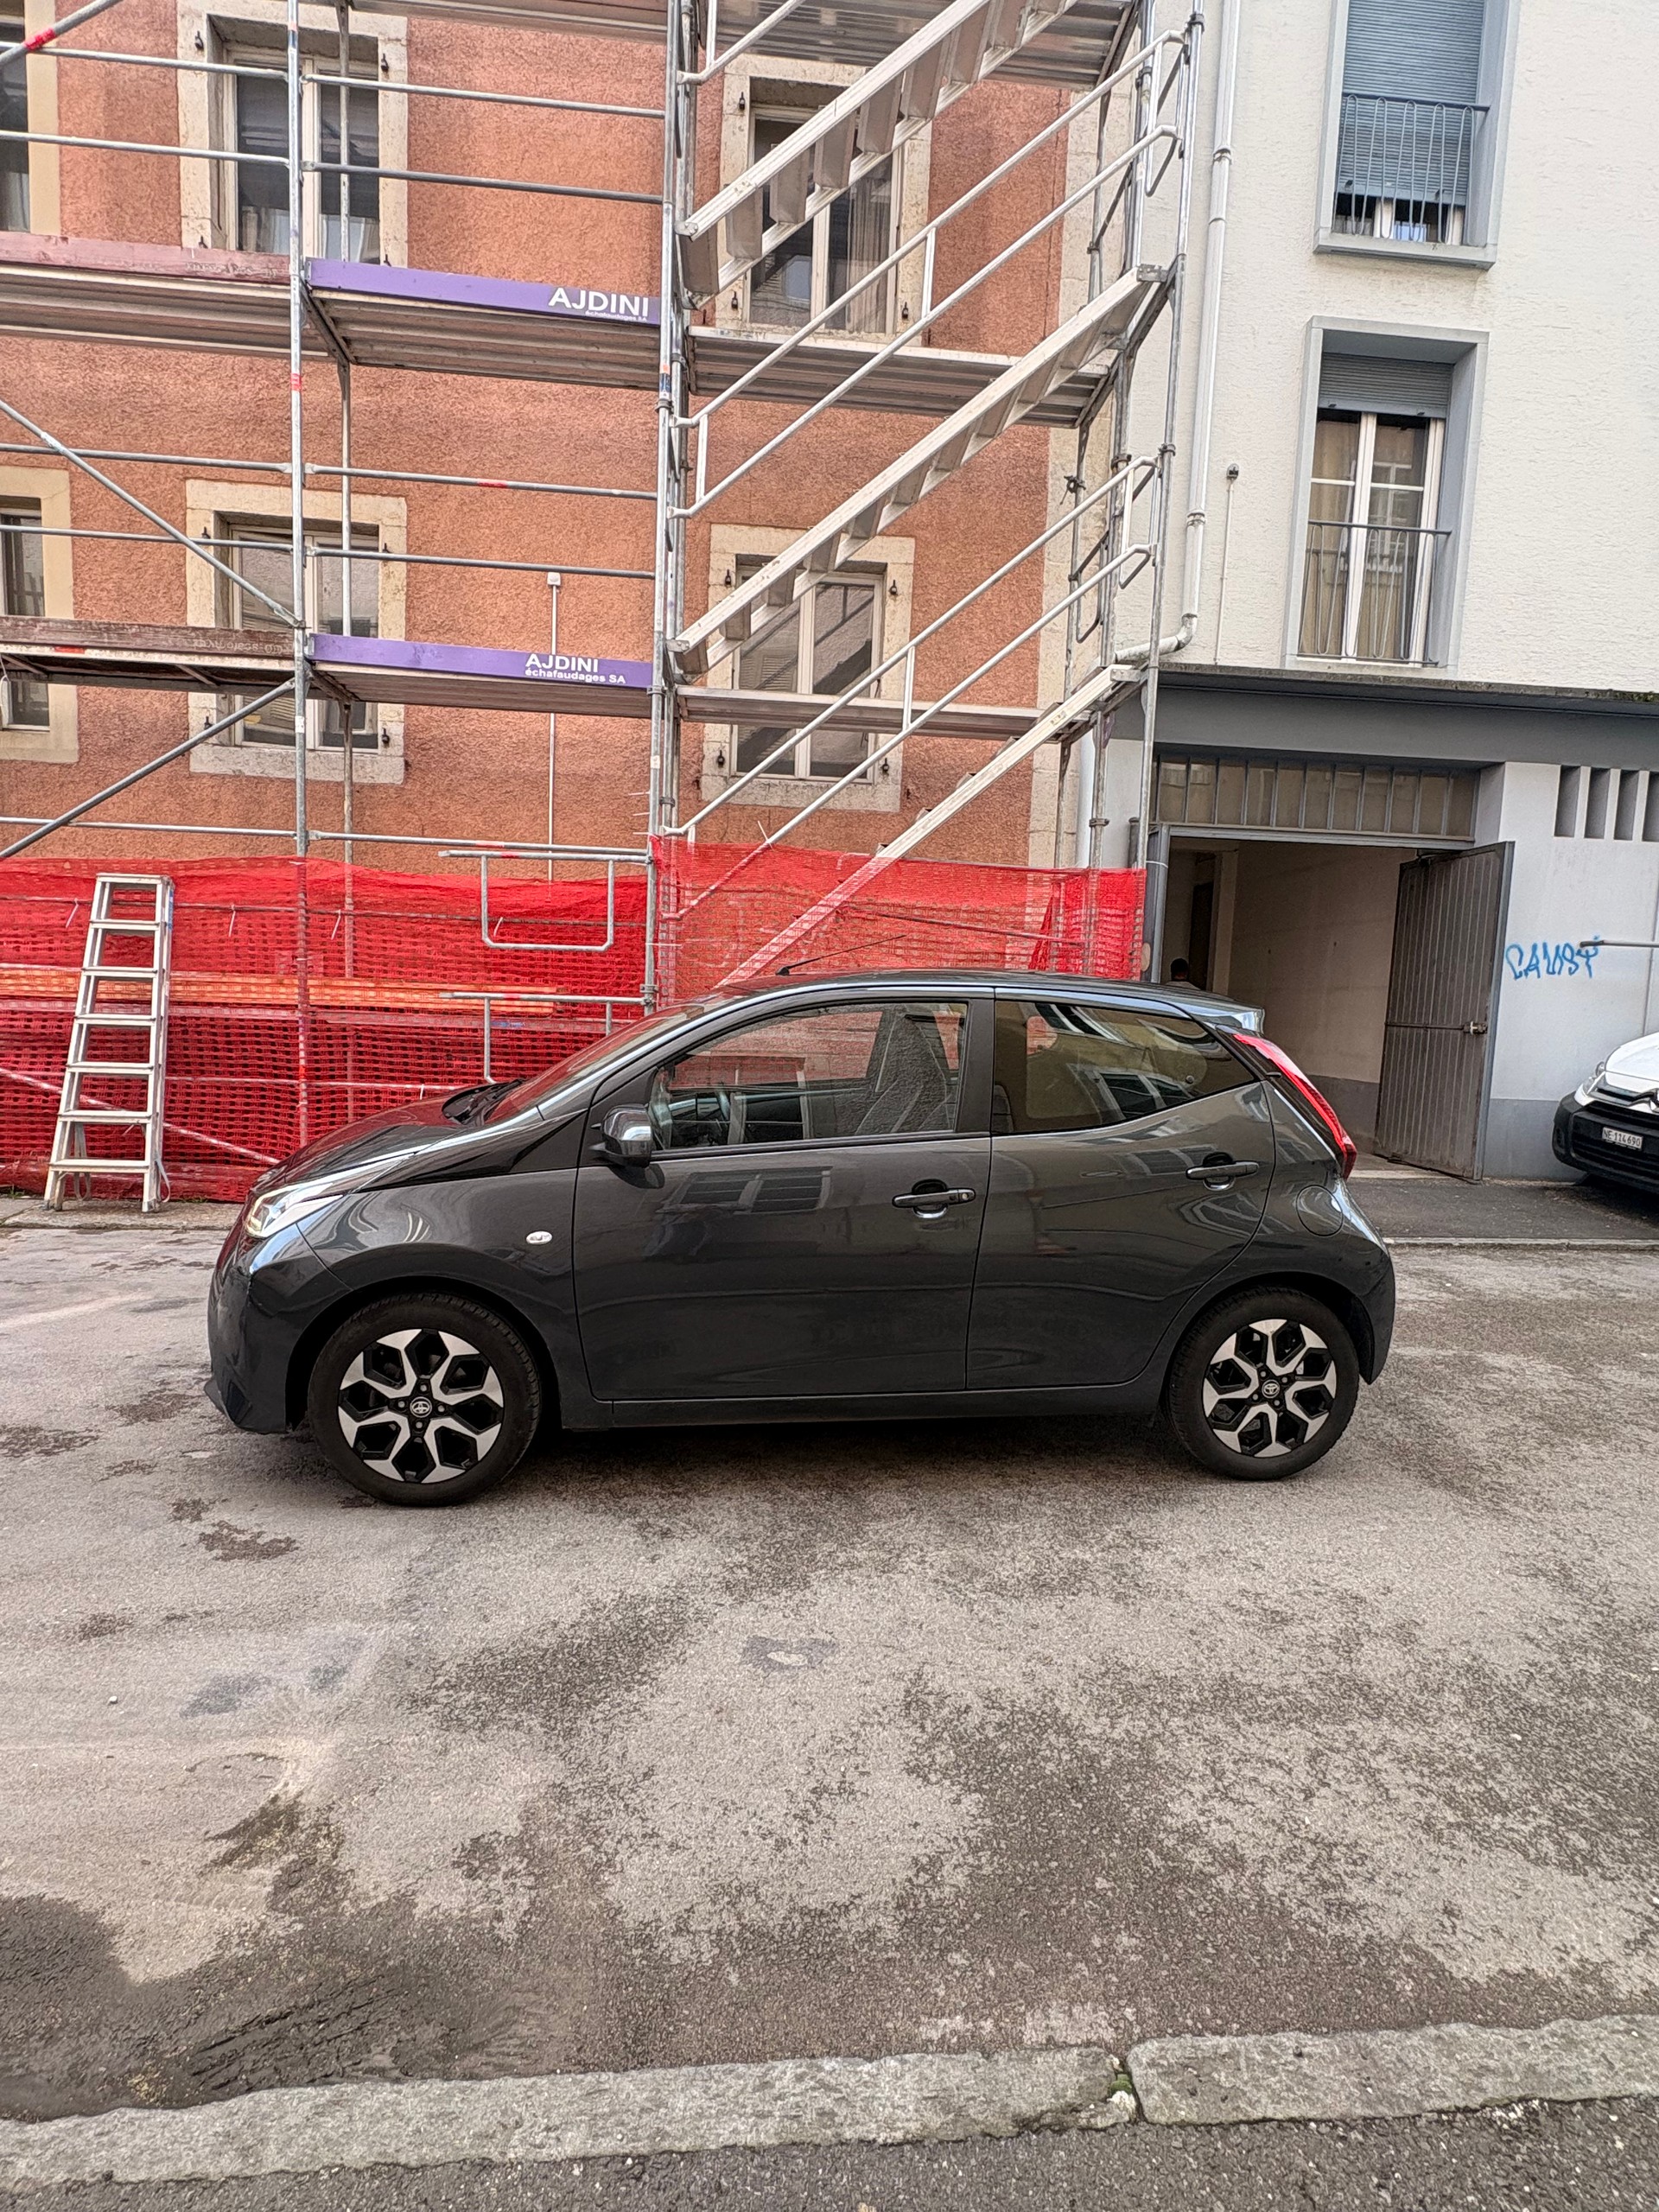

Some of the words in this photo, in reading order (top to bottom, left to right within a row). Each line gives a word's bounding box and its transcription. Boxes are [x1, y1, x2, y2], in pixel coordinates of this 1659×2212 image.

[549, 287, 649, 317] AJDINI
[525, 653, 599, 673] AJDINI
[524, 668, 607, 683] échafaudages
[608, 674, 626, 684] SA
